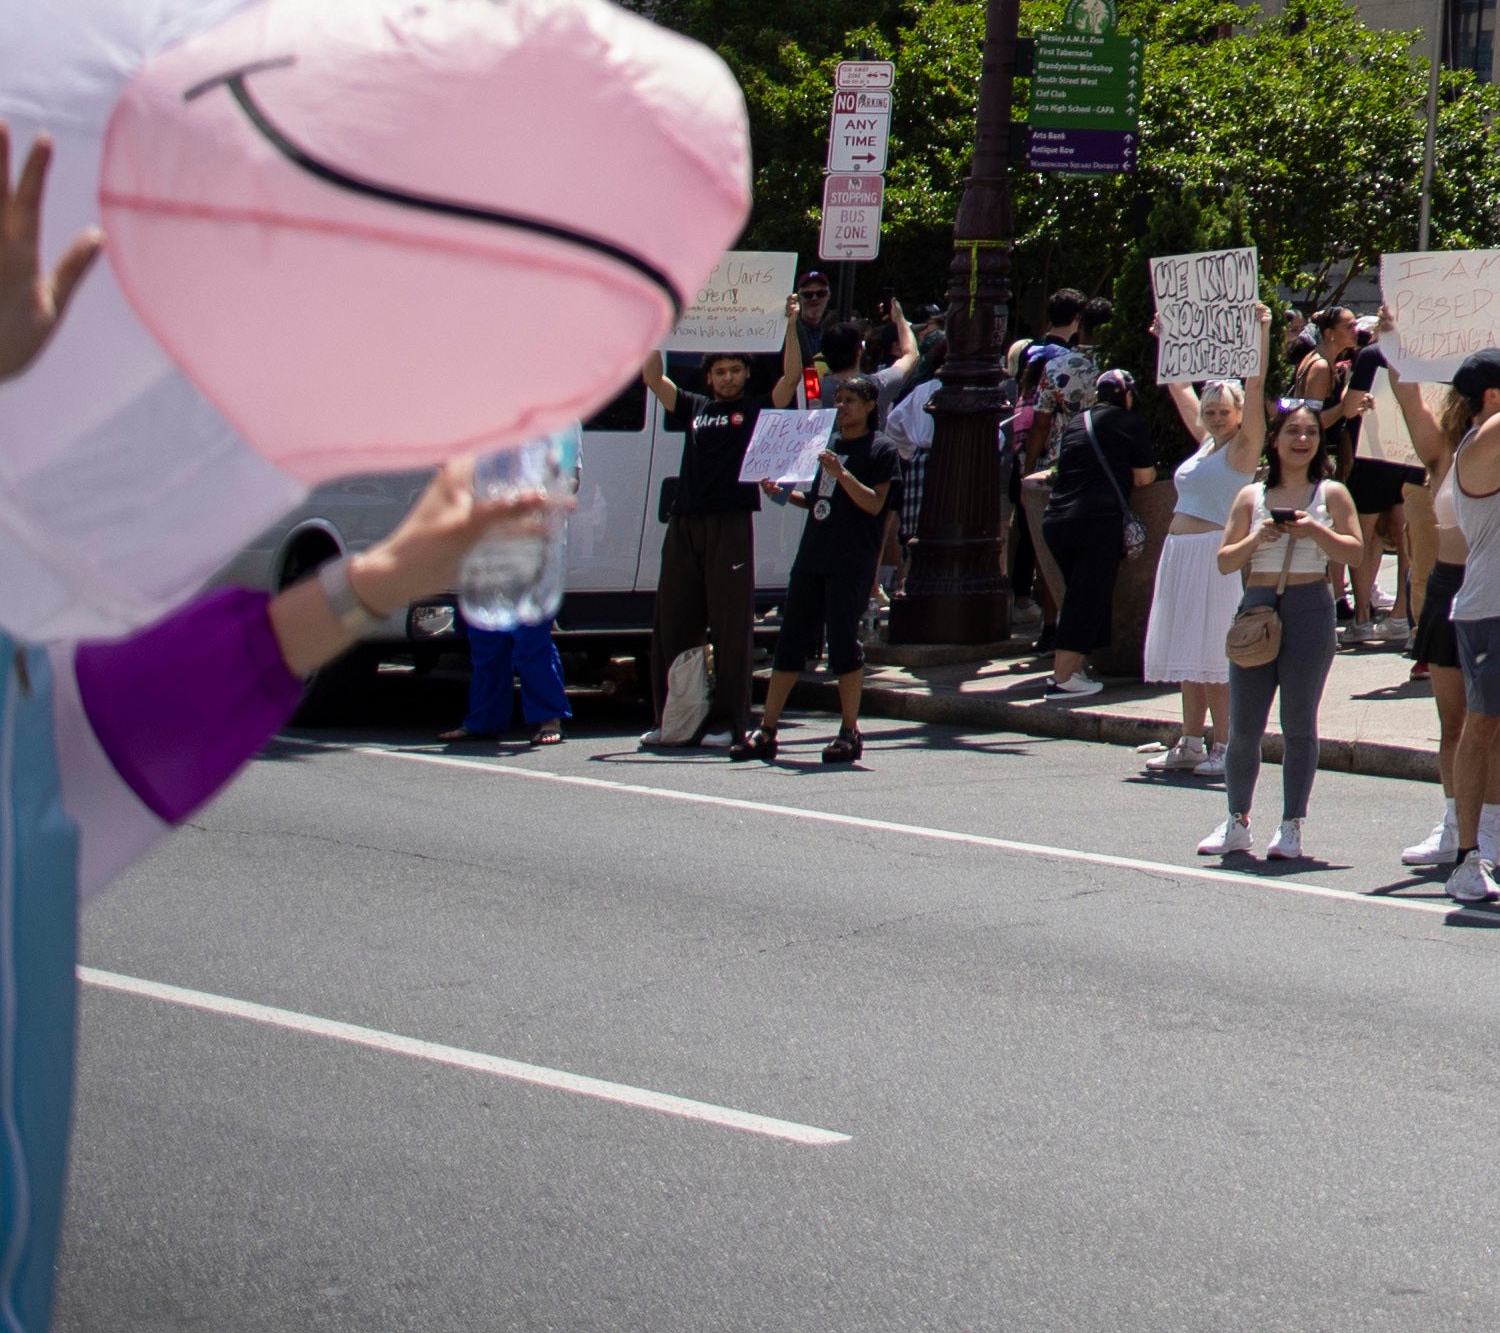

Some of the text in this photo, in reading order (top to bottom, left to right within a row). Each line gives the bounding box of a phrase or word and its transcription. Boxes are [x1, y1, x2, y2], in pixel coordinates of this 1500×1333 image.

[837, 93, 888, 111] NO PARKING
[845, 119, 878, 131] ANY
[843, 135, 877, 147] TIME
[848, 177, 863, 191] NO
[831, 191, 878, 205] STOPPING
[839, 209, 866, 224] BUS
[834, 225, 868, 240] ZONE
[1154, 251, 1256, 303] WE KNOW
[1398, 256, 1438, 281] I
[1394, 288, 1495, 326] PISSED
[1163, 300, 1257, 350] YOU KNEW
[1397, 328, 1482, 361] HOLDING
[1160, 338, 1260, 378] MONTHS AGO
[759, 413, 789, 435] THE
